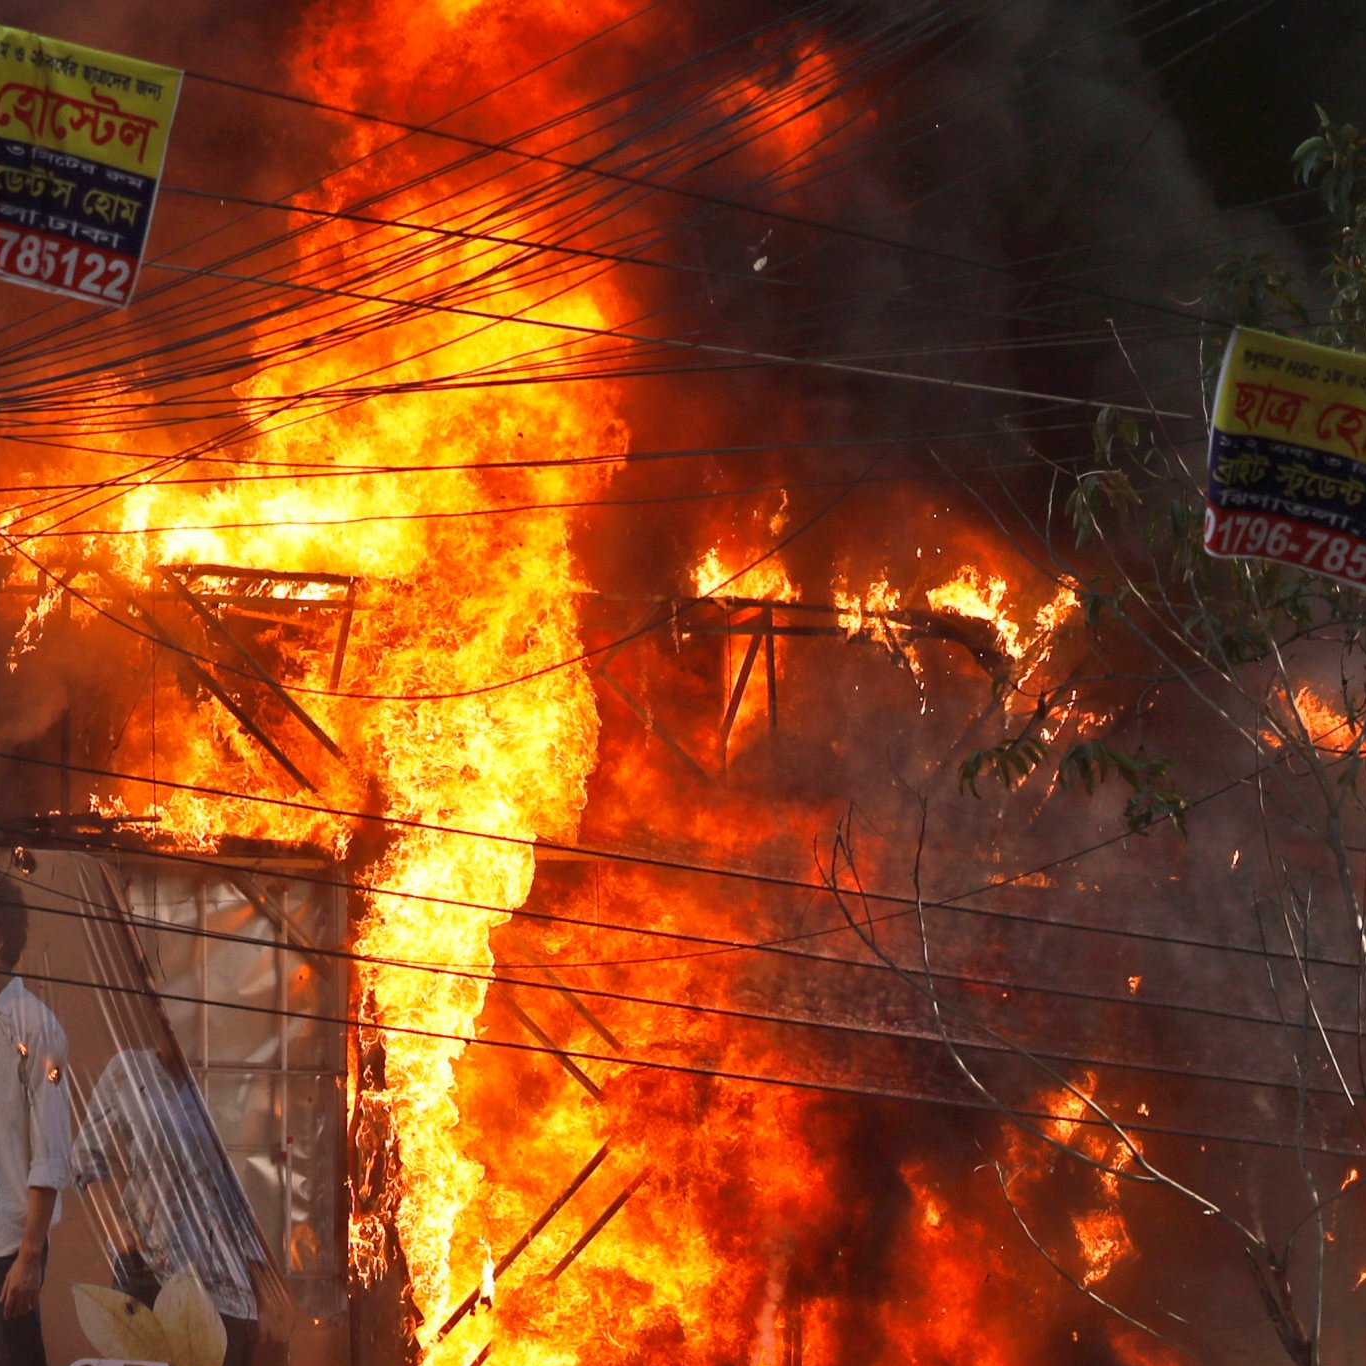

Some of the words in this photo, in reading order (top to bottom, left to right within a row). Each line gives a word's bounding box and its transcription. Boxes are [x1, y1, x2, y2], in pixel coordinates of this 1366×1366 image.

[82, 188, 143, 227] হোম
[1286, 359, 1321, 381] HSC
[1235, 380, 1312, 432] ছাত্র
